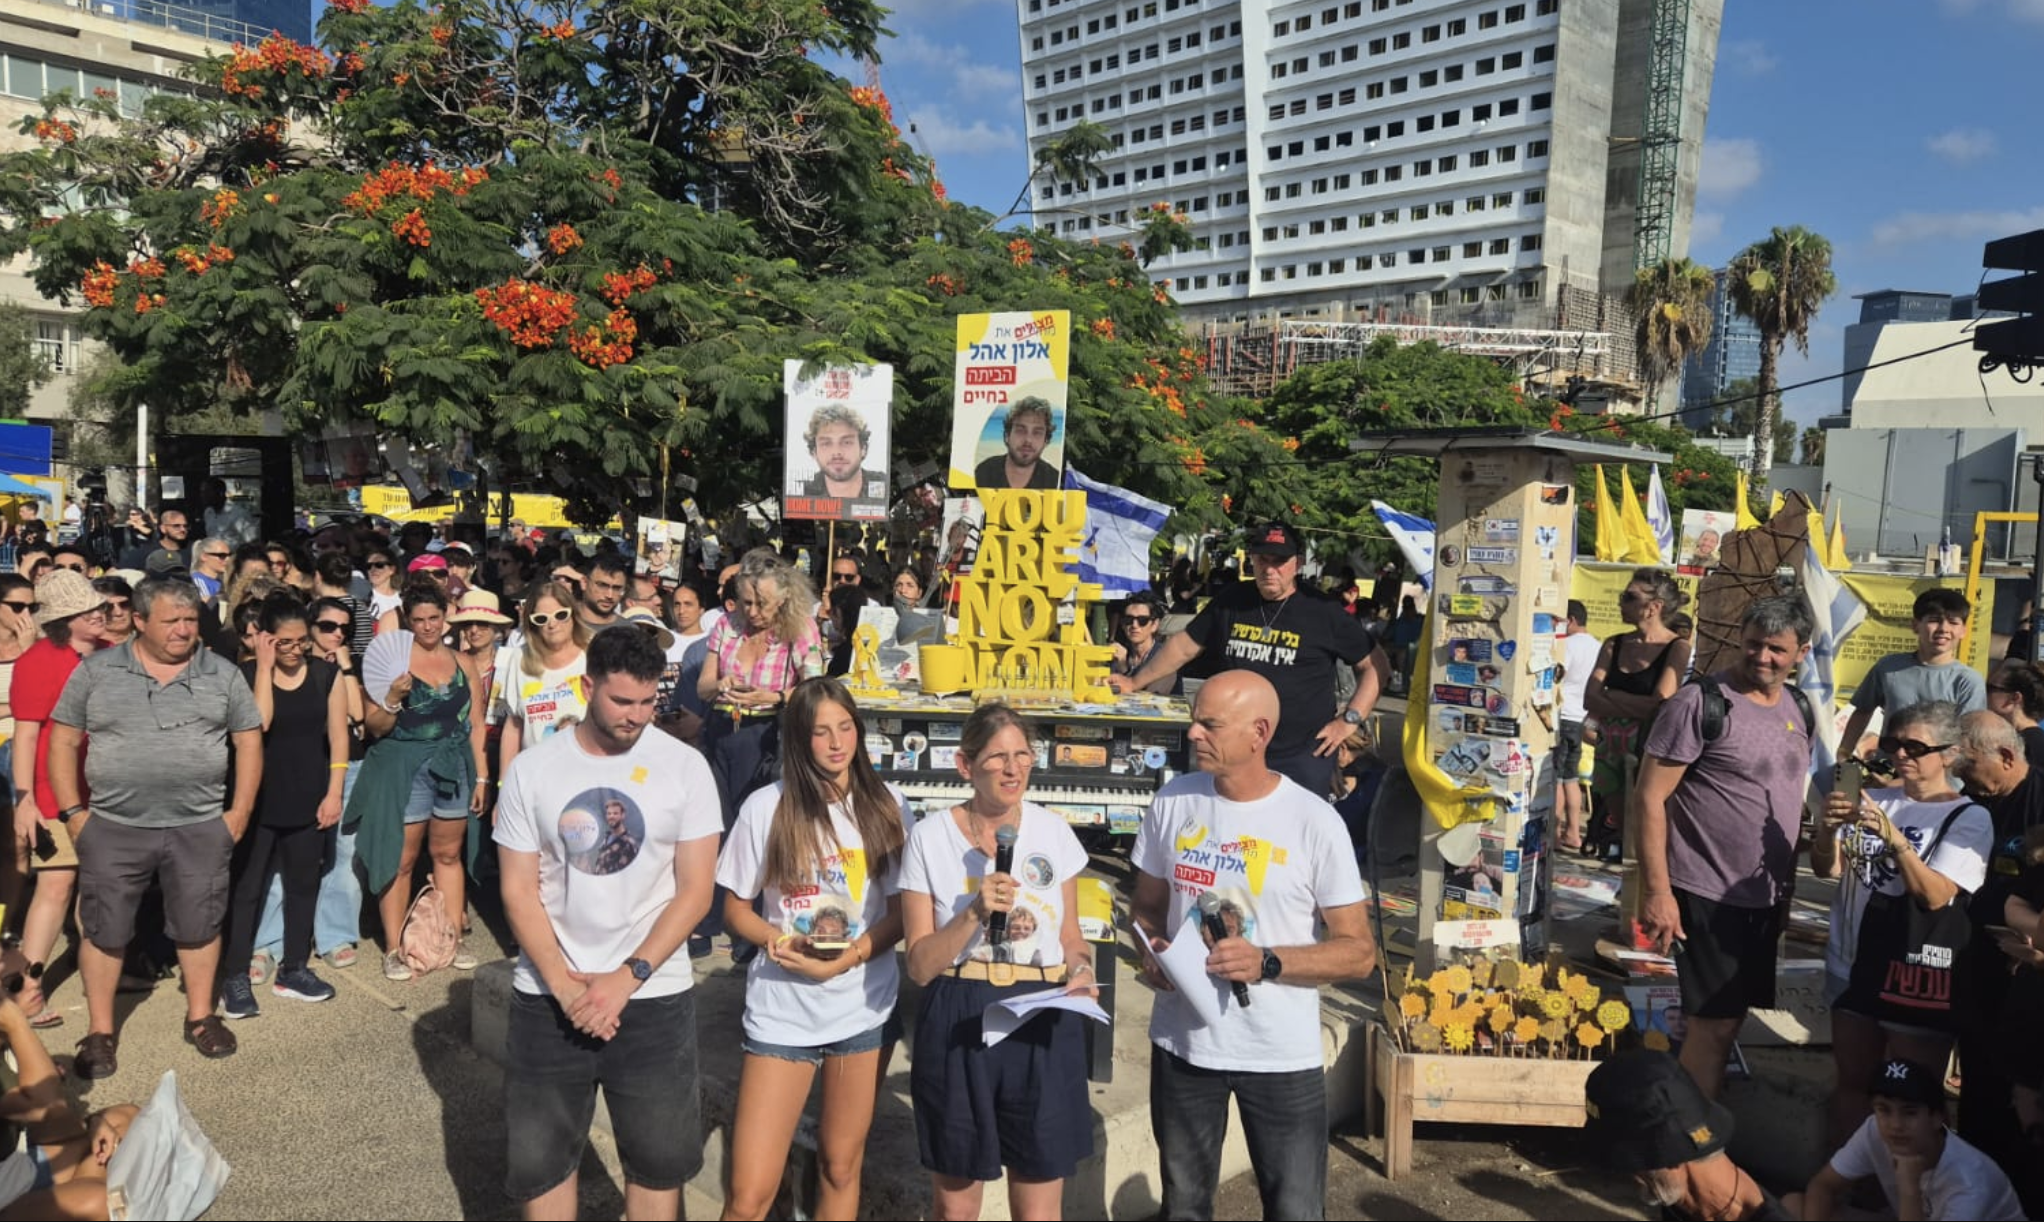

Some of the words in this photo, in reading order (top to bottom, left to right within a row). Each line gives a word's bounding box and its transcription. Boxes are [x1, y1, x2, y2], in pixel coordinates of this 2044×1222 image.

[996, 327, 1011, 338] את
[969, 341, 1007, 360] אהל
[1012, 340, 1050, 364] אלון
[967, 368, 1013, 383] הביתה
[963, 390, 1008, 404] בחיים
[975, 488, 1087, 533] YOU
[971, 529, 1085, 589] ARE
[958, 580, 1104, 646] NOT
[1273, 646, 1297, 665] אין
[958, 642, 1118, 703] ALONE
[1181, 846, 1212, 866] אהל
[1213, 854, 1248, 874] אלון
[1175, 864, 1213, 885] הביתה
